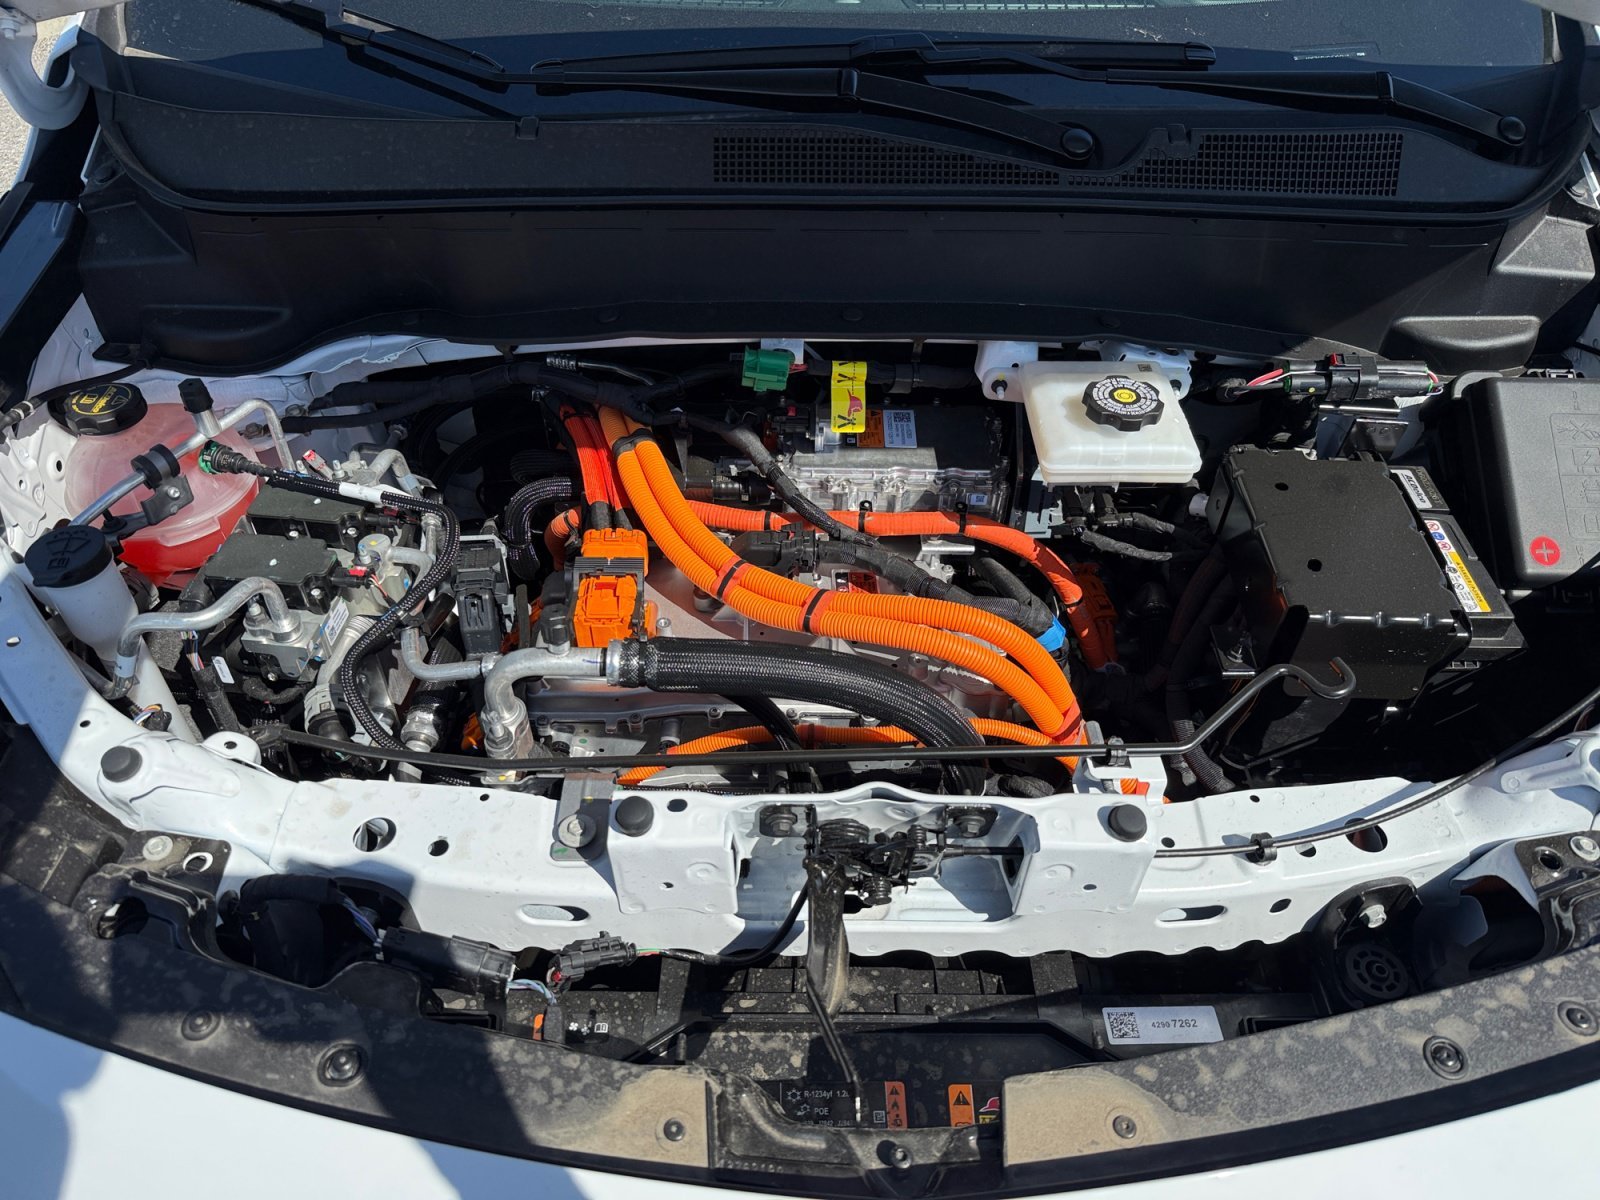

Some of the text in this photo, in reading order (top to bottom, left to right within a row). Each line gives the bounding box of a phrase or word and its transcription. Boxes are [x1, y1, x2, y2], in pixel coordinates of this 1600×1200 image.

[1405, 474, 1426, 503] ACDelco
[803, 1090, 833, 1099] R-1234yf
[814, 1107, 829, 1115] POE
